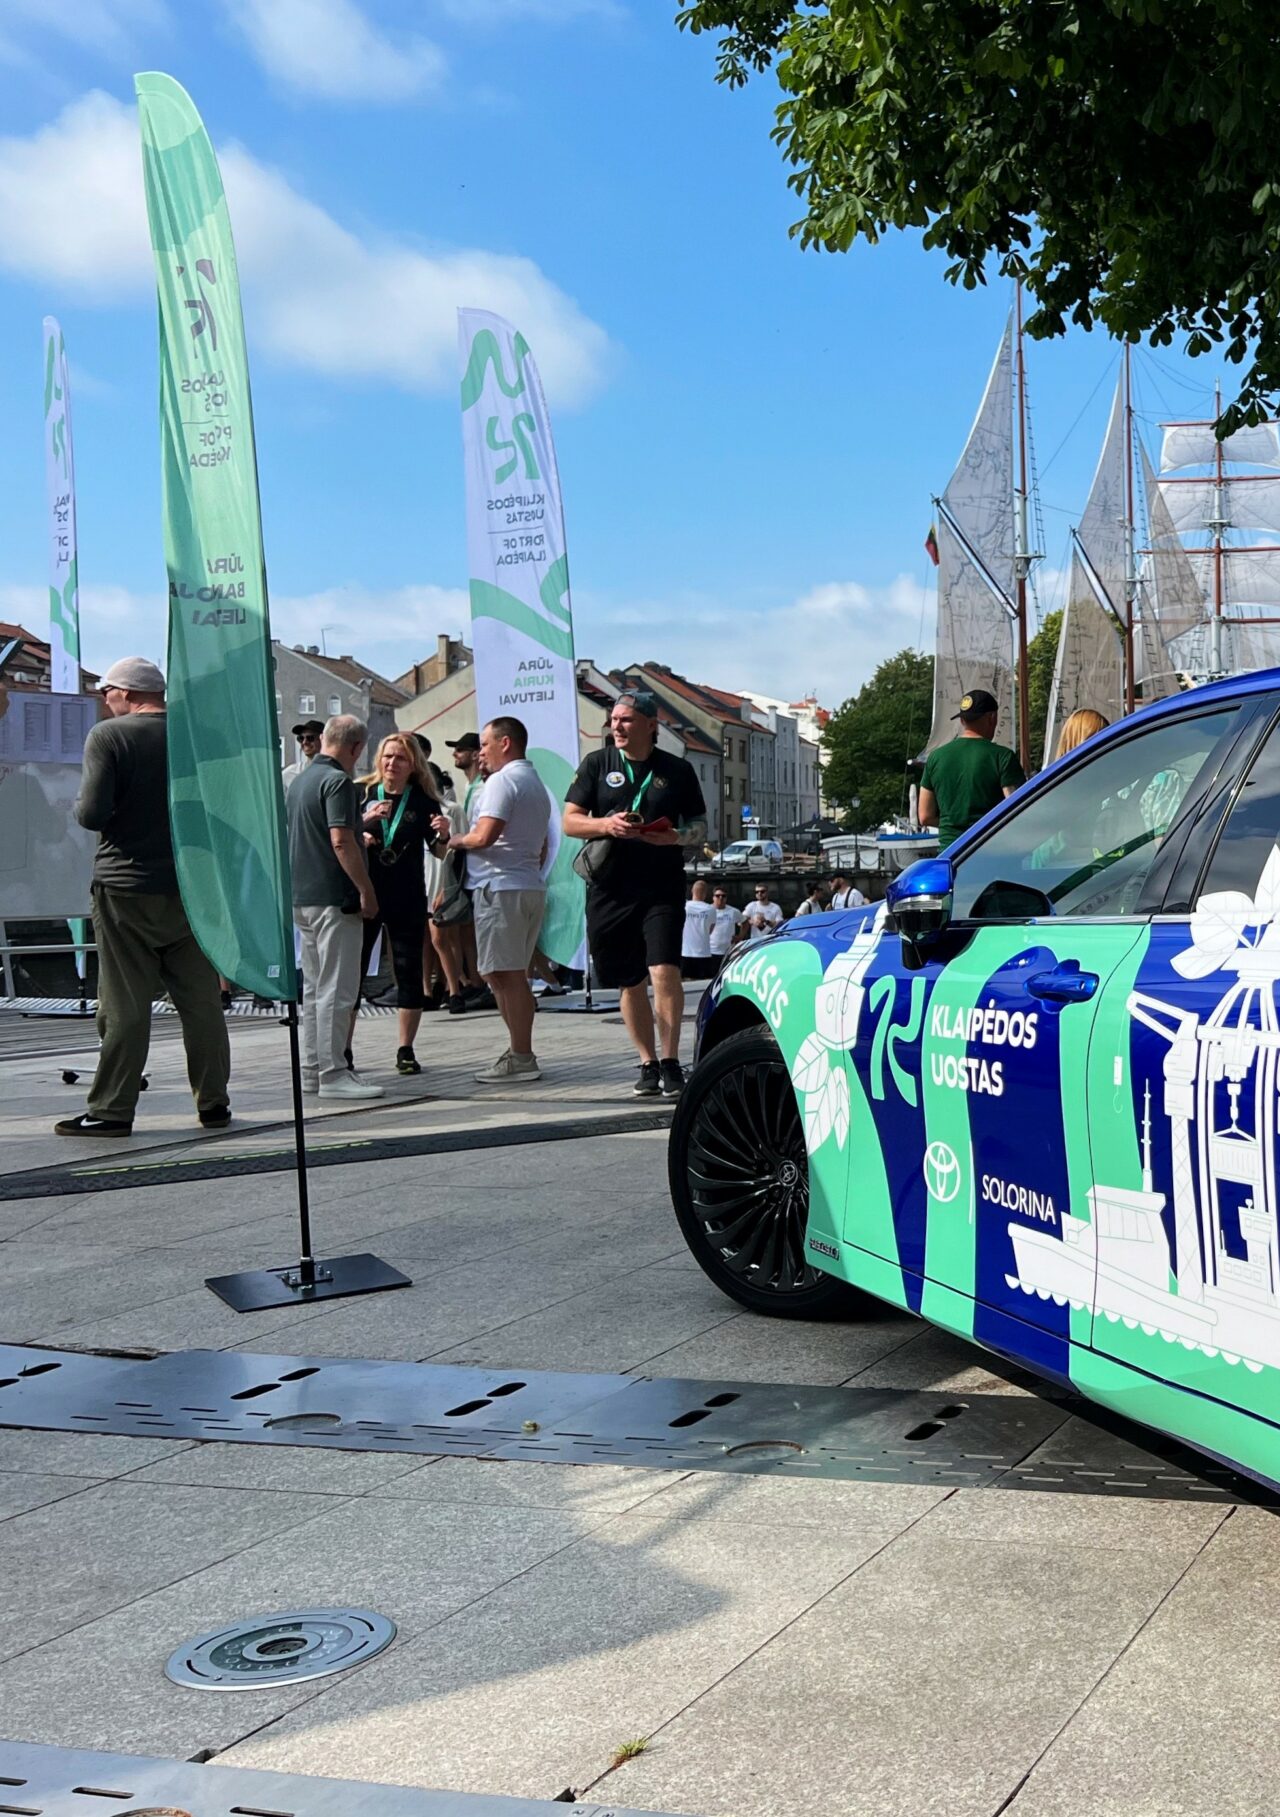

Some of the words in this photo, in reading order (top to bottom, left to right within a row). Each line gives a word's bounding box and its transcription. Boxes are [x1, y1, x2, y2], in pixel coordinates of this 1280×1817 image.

[930, 998, 1039, 1049] KLAIPĖDOS
[930, 1052, 1004, 1096] UOSTAS
[981, 1174, 1057, 1226] SOLORINA
